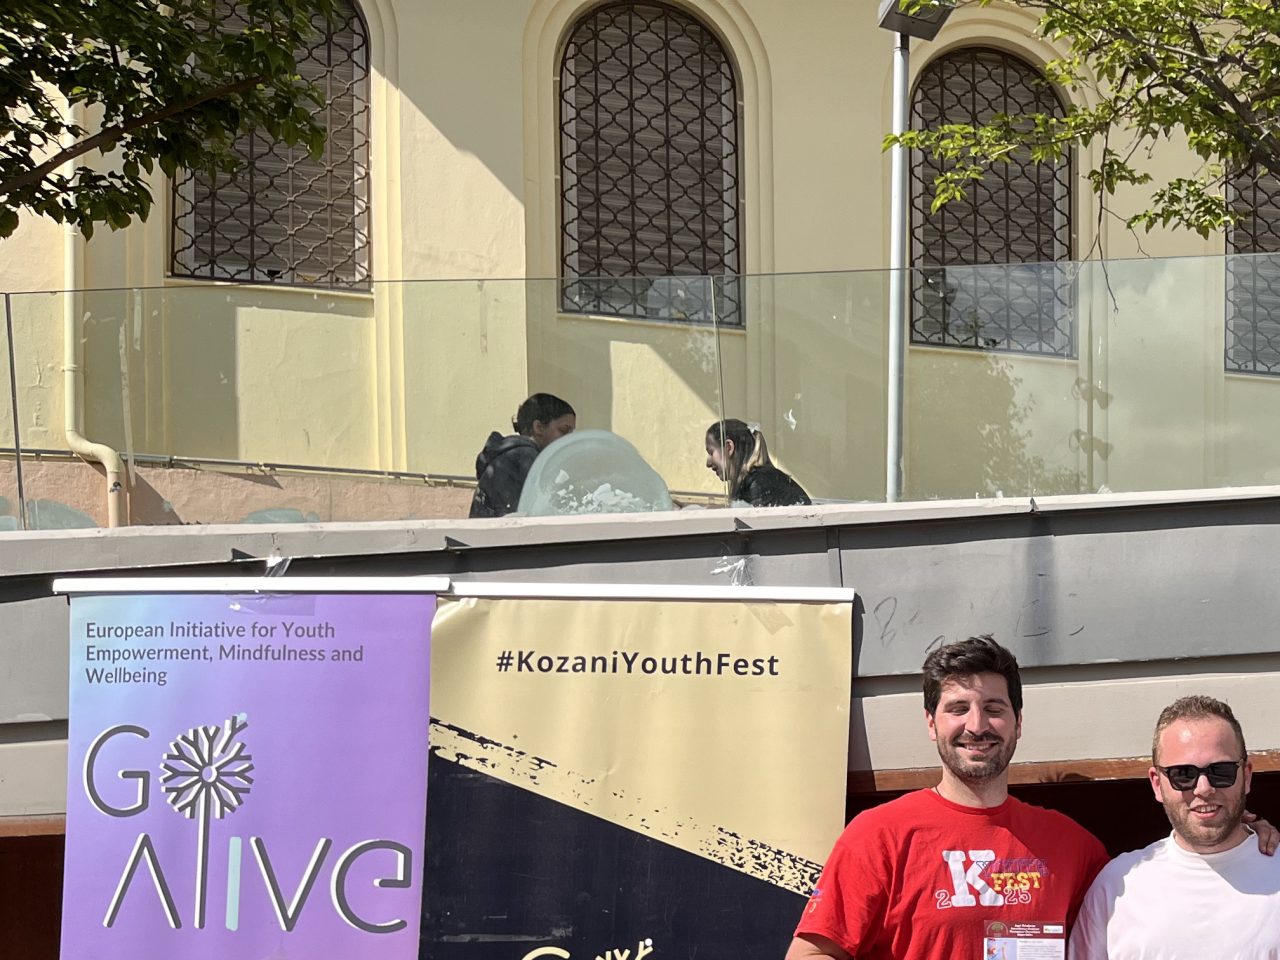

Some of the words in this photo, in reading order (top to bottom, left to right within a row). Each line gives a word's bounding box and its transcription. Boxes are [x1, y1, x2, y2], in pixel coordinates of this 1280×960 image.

[86, 622, 164, 641] European
[170, 622, 246, 639] Initiative
[251, 622, 277, 639] for
[282, 622, 335, 639] Youth
[86, 646, 213, 664] Empowerment,
[219, 646, 326, 662] Mindfulness
[331, 646, 364, 662] and
[496, 650, 780, 676] #KozaniYouthFest
[85, 667, 168, 686] Wellbeing
[991, 872, 1041, 891] FEST
